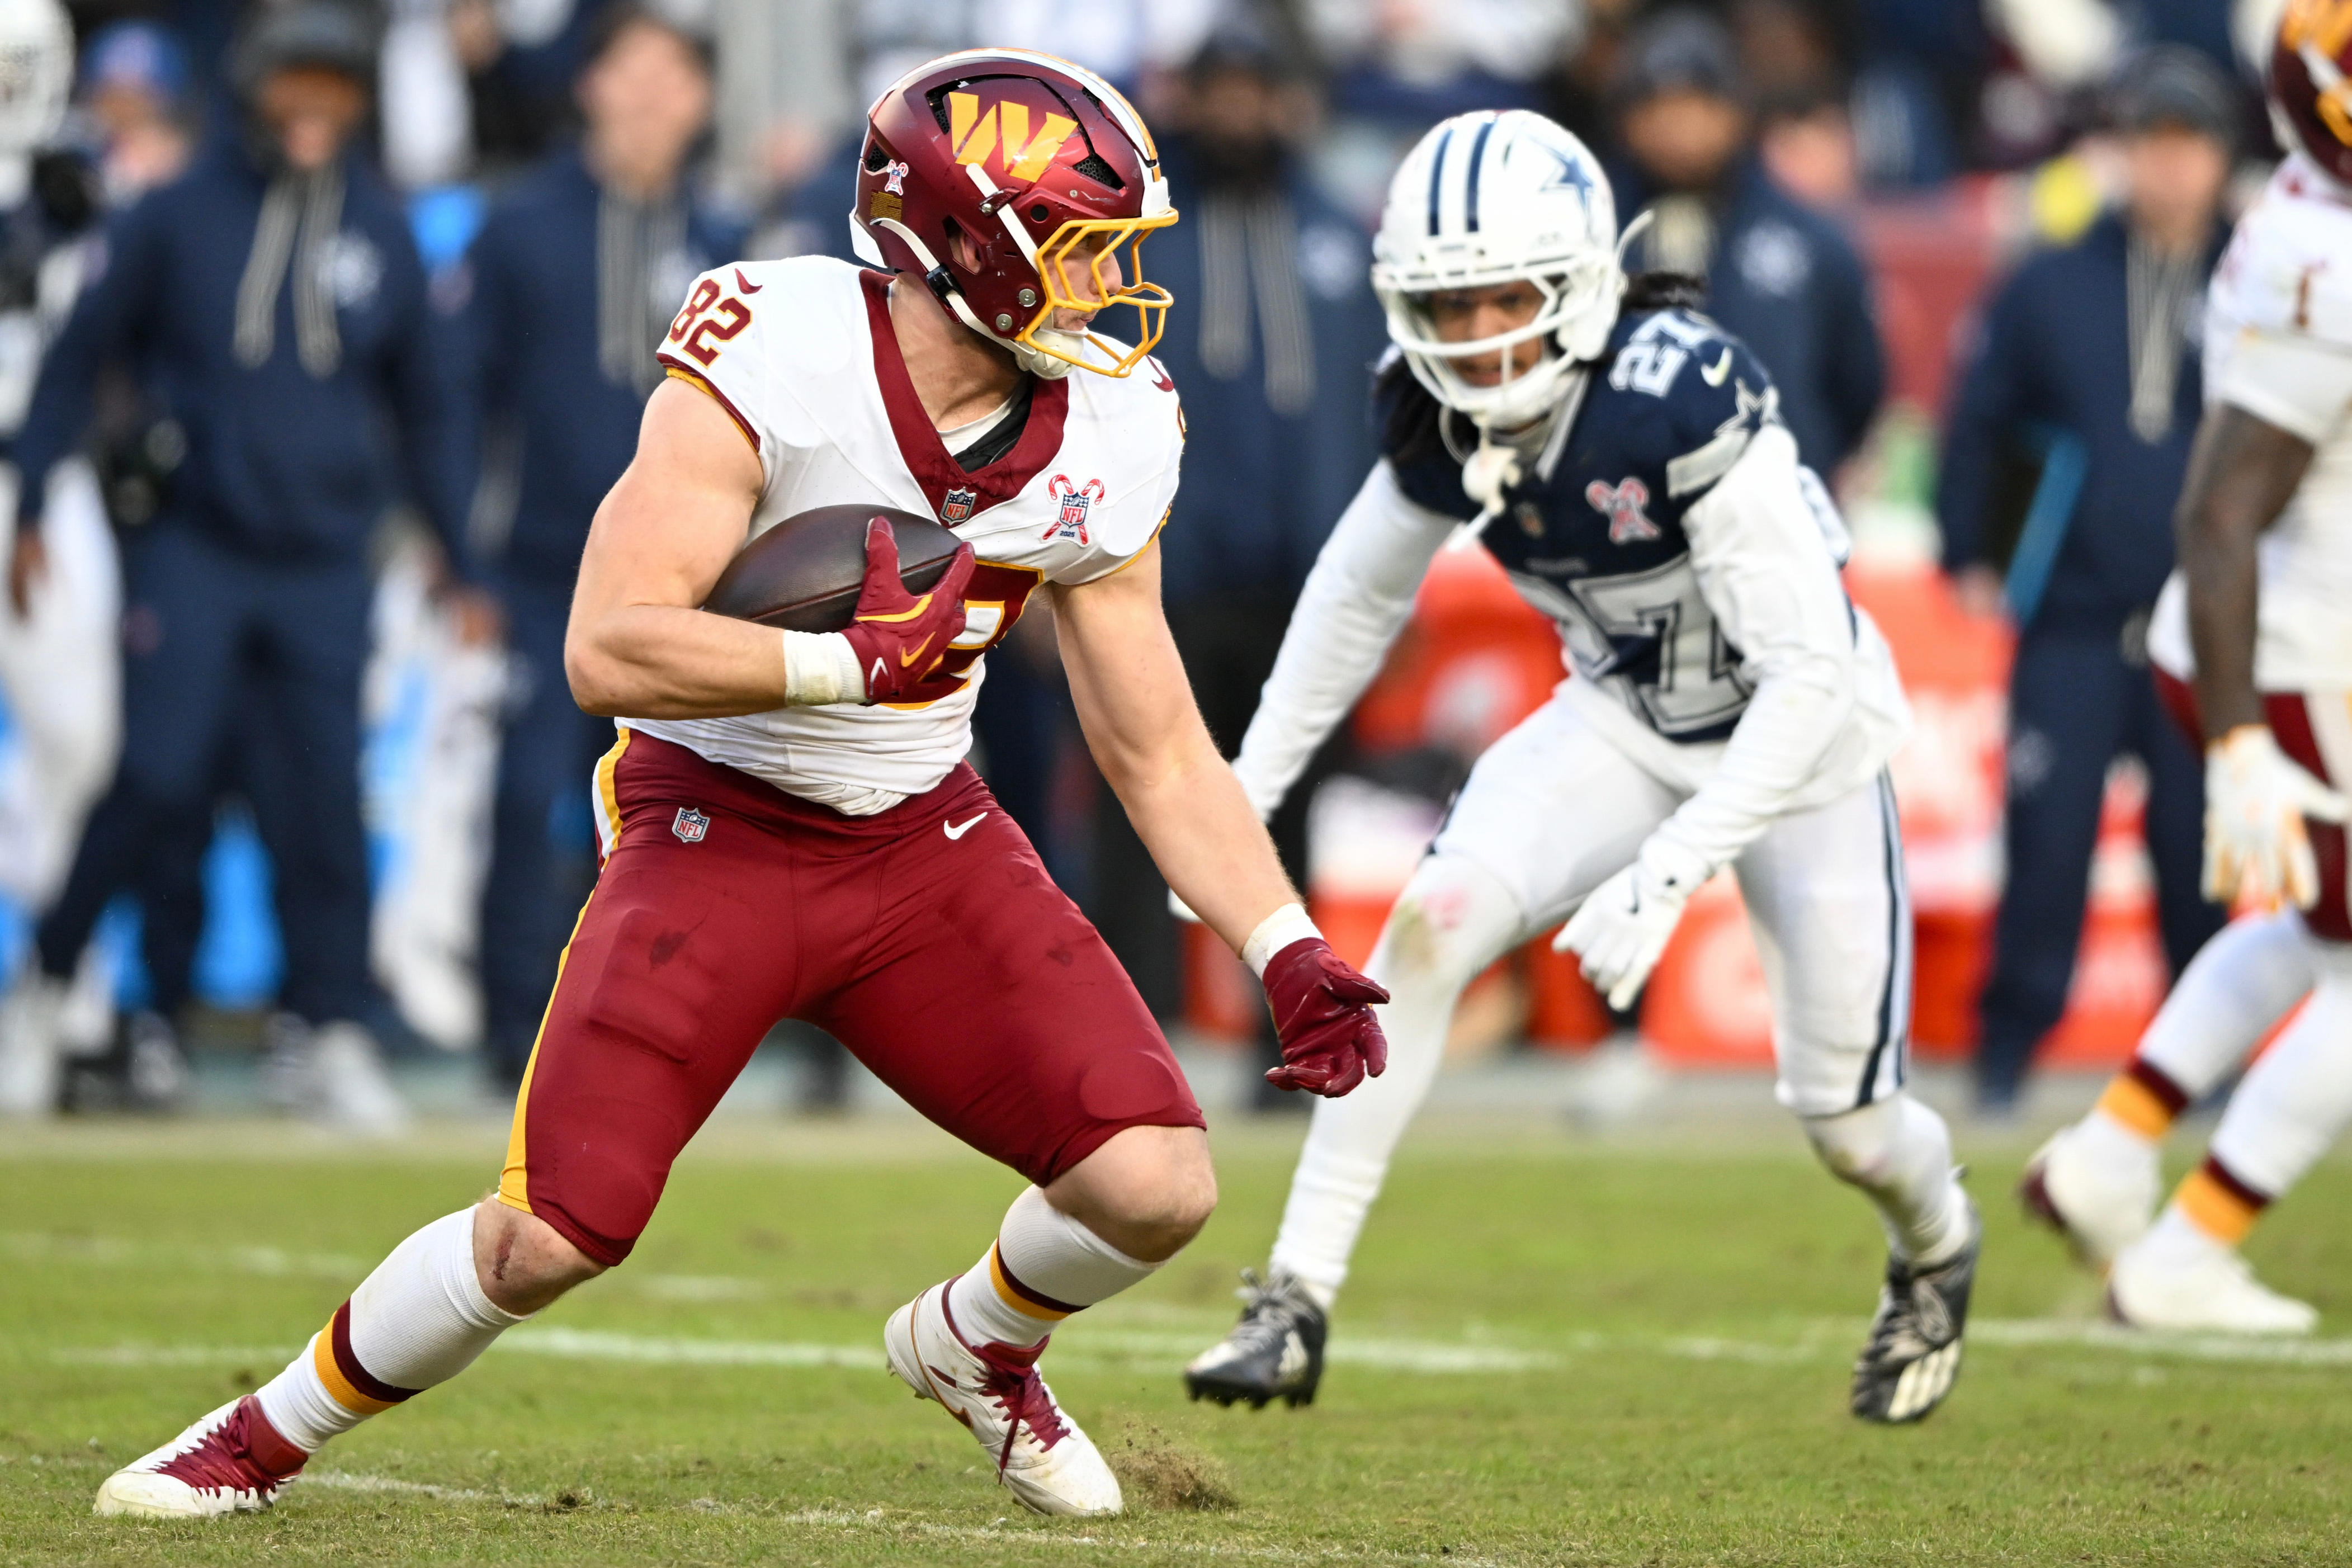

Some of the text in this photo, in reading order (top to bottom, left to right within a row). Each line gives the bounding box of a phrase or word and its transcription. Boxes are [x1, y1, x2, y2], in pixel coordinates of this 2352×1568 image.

[668, 278, 753, 370] 82
[945, 504, 966, 518] NFL
[1061, 506, 1083, 524] NFL
[678, 820, 700, 837] NFL
